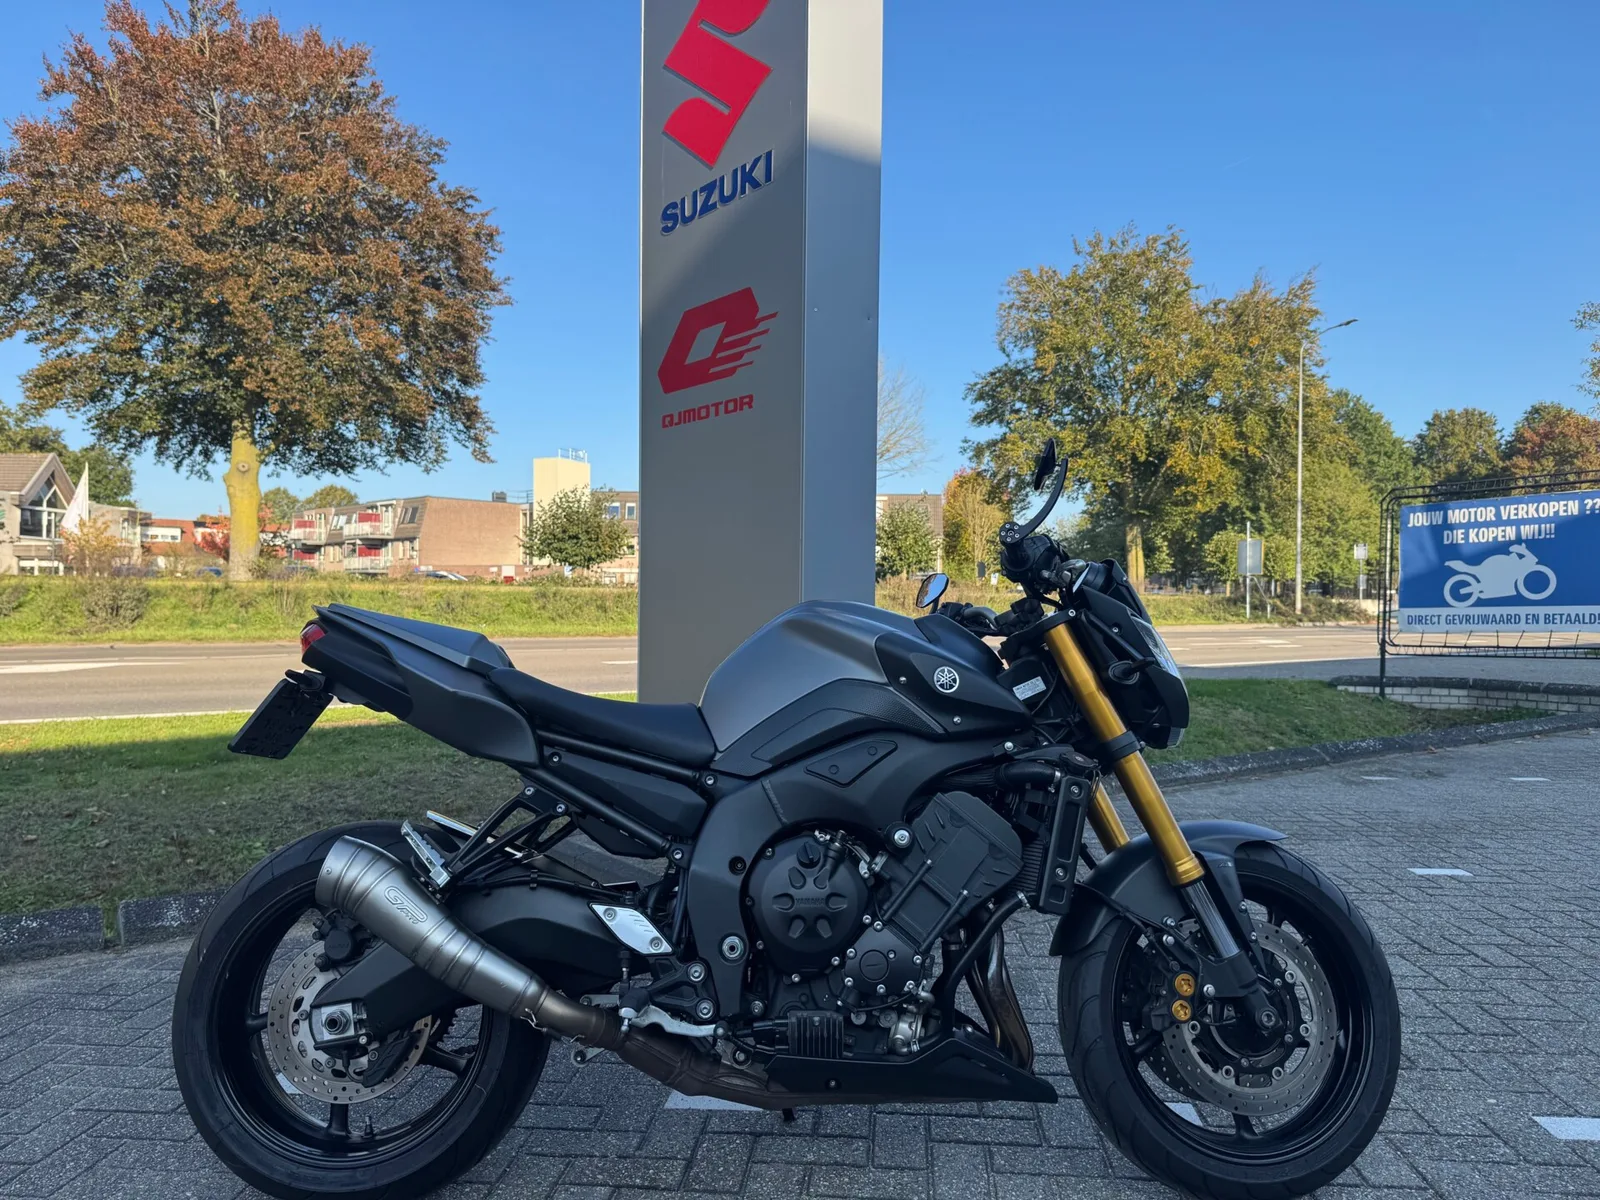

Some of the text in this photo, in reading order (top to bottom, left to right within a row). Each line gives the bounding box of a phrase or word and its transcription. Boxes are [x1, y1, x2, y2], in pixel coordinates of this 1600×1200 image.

[660, 149, 774, 236] SUZUKI
[661, 393, 754, 429] QJMOTOR
[1407, 510, 1444, 528] JOUW
[1447, 506, 1496, 524] MOTOR
[1500, 500, 1579, 520] VERKOPEN
[1443, 523, 1555, 545] DIE KOPEN WIJ!!
[1407, 614, 1442, 626] DIRECT
[1445, 613, 1521, 626] GEVRIJWAARD
[1525, 613, 1540, 625] EN
